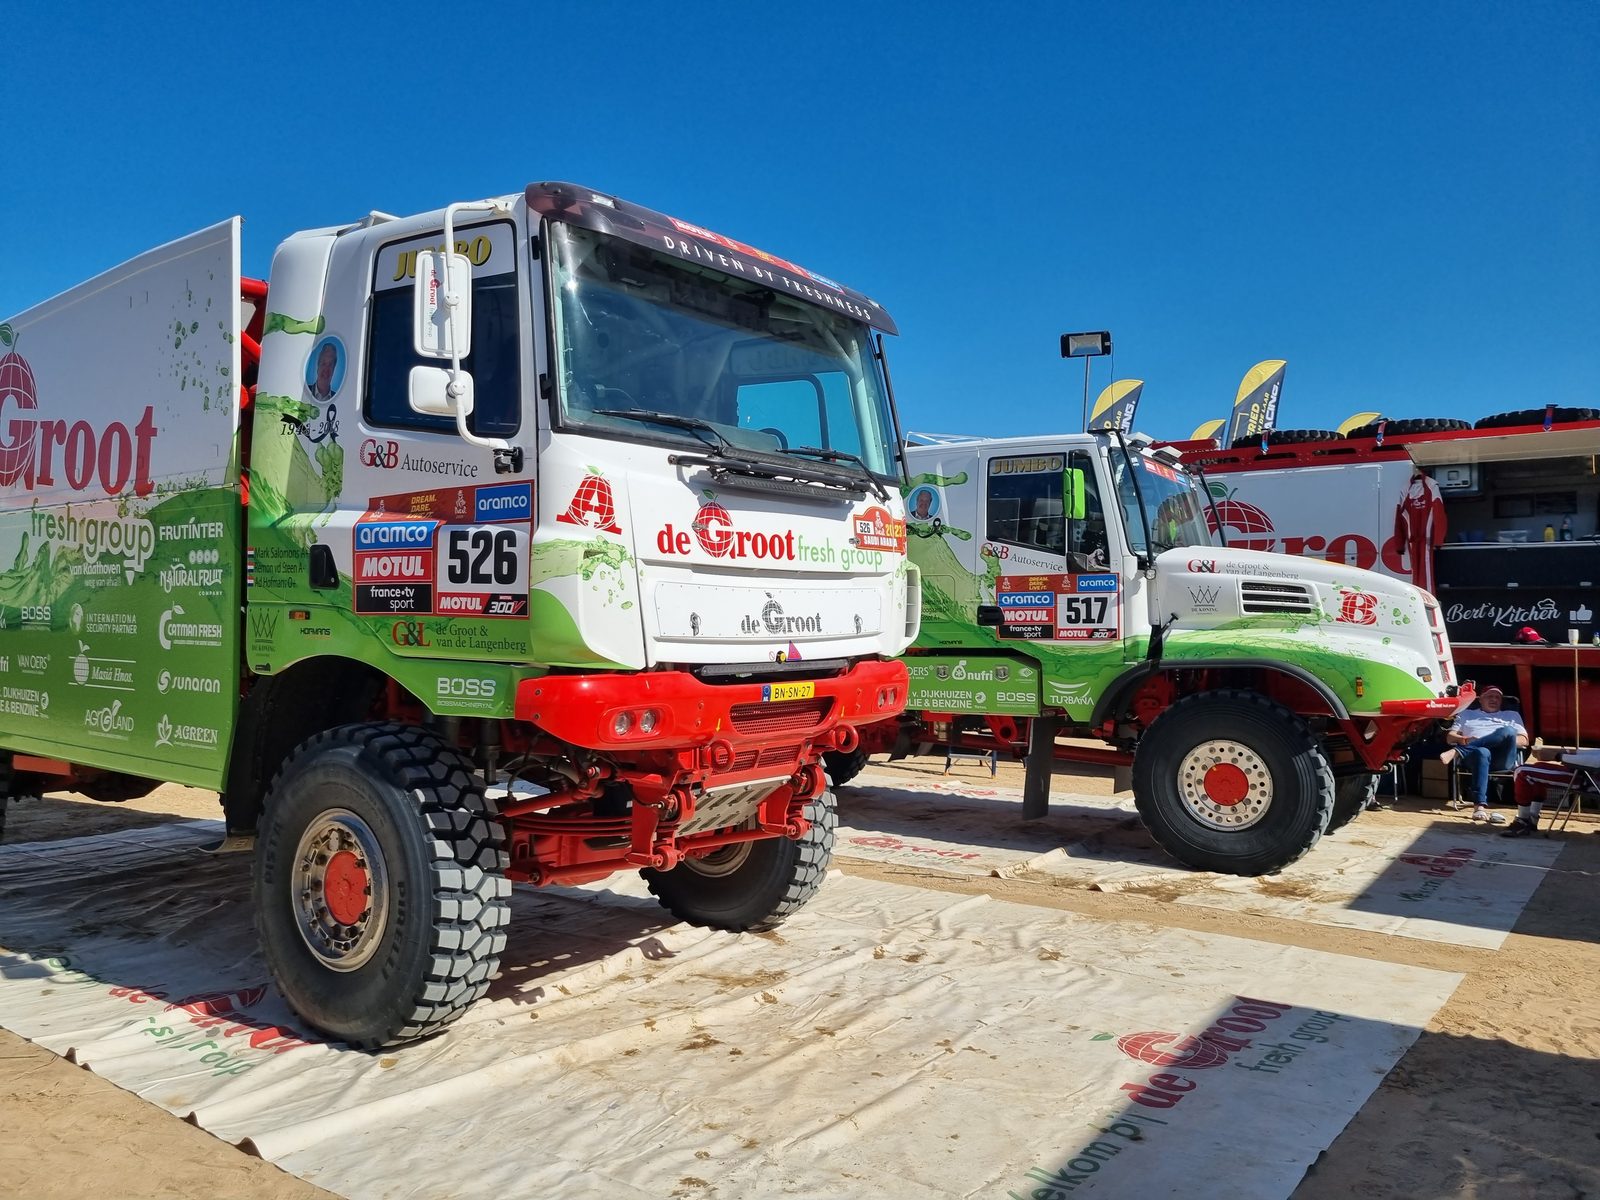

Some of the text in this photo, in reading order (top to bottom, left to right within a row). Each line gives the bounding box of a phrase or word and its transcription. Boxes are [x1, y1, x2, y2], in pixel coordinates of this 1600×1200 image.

[664, 235, 744, 272] DRIVEN
[753, 265, 774, 282] BY
[782, 276, 871, 320] FRESHNESS
[1262, 392, 1270, 412] LAAR
[360, 439, 478, 478] G&B Autoservice
[991, 457, 1062, 474] JUMBO
[411, 494, 437, 505] DREAM.
[478, 495, 528, 511] aramco
[31, 498, 152, 565] fresh group
[360, 525, 427, 544] aramco
[860, 522, 870, 533] 526
[657, 501, 884, 571] de Groot fresh group
[864, 535, 880, 546] SAUDI
[1203, 500, 1413, 575] Groo
[447, 530, 517, 585] 526
[1010, 553, 1063, 572] Autoservice
[1238, 561, 1261, 569] Groot
[362, 556, 424, 577] MOTUL
[1187, 559, 1220, 574] G&L
[1253, 569, 1299, 580] Langenberg
[1079, 579, 1115, 587] aramco
[389, 599, 414, 613] sport
[439, 596, 483, 610] MOTUL
[1001, 595, 1050, 604] aramco
[21, 606, 51, 621] BOSS
[489, 601, 526, 614] 300V
[1066, 597, 1108, 624] 517
[741, 599, 822, 635] de Groot
[1004, 610, 1048, 621] MOTUL
[1493, 605, 1561, 627] Kitchen
[86, 624, 138, 634] SECURITY PARTNER
[198, 624, 222, 638] FRESH
[392, 621, 431, 647] G&L
[436, 622, 488, 637] de Groot &
[1024, 631, 1041, 639] sport
[436, 637, 526, 654] van de Langenberg
[18, 654, 29, 667] VAN
[965, 670, 993, 681] nufri
[437, 677, 496, 696] BOSS
[774, 686, 811, 698] BN-SN-27
[3, 687, 40, 702] DIJKHUIZEN
[920, 691, 972, 699] DIJKHUIZEN
[996, 692, 1036, 702] BOSS
[5, 703, 39, 717] & BENZINE
[924, 699, 930, 707] &
[932, 699, 972, 709] BENZINE
[174, 724, 219, 744] AGREEN
[1116, 995, 1293, 1070] Groot
[1234, 1010, 1353, 1074] fresh group
[1119, 1072, 1196, 1108] de
